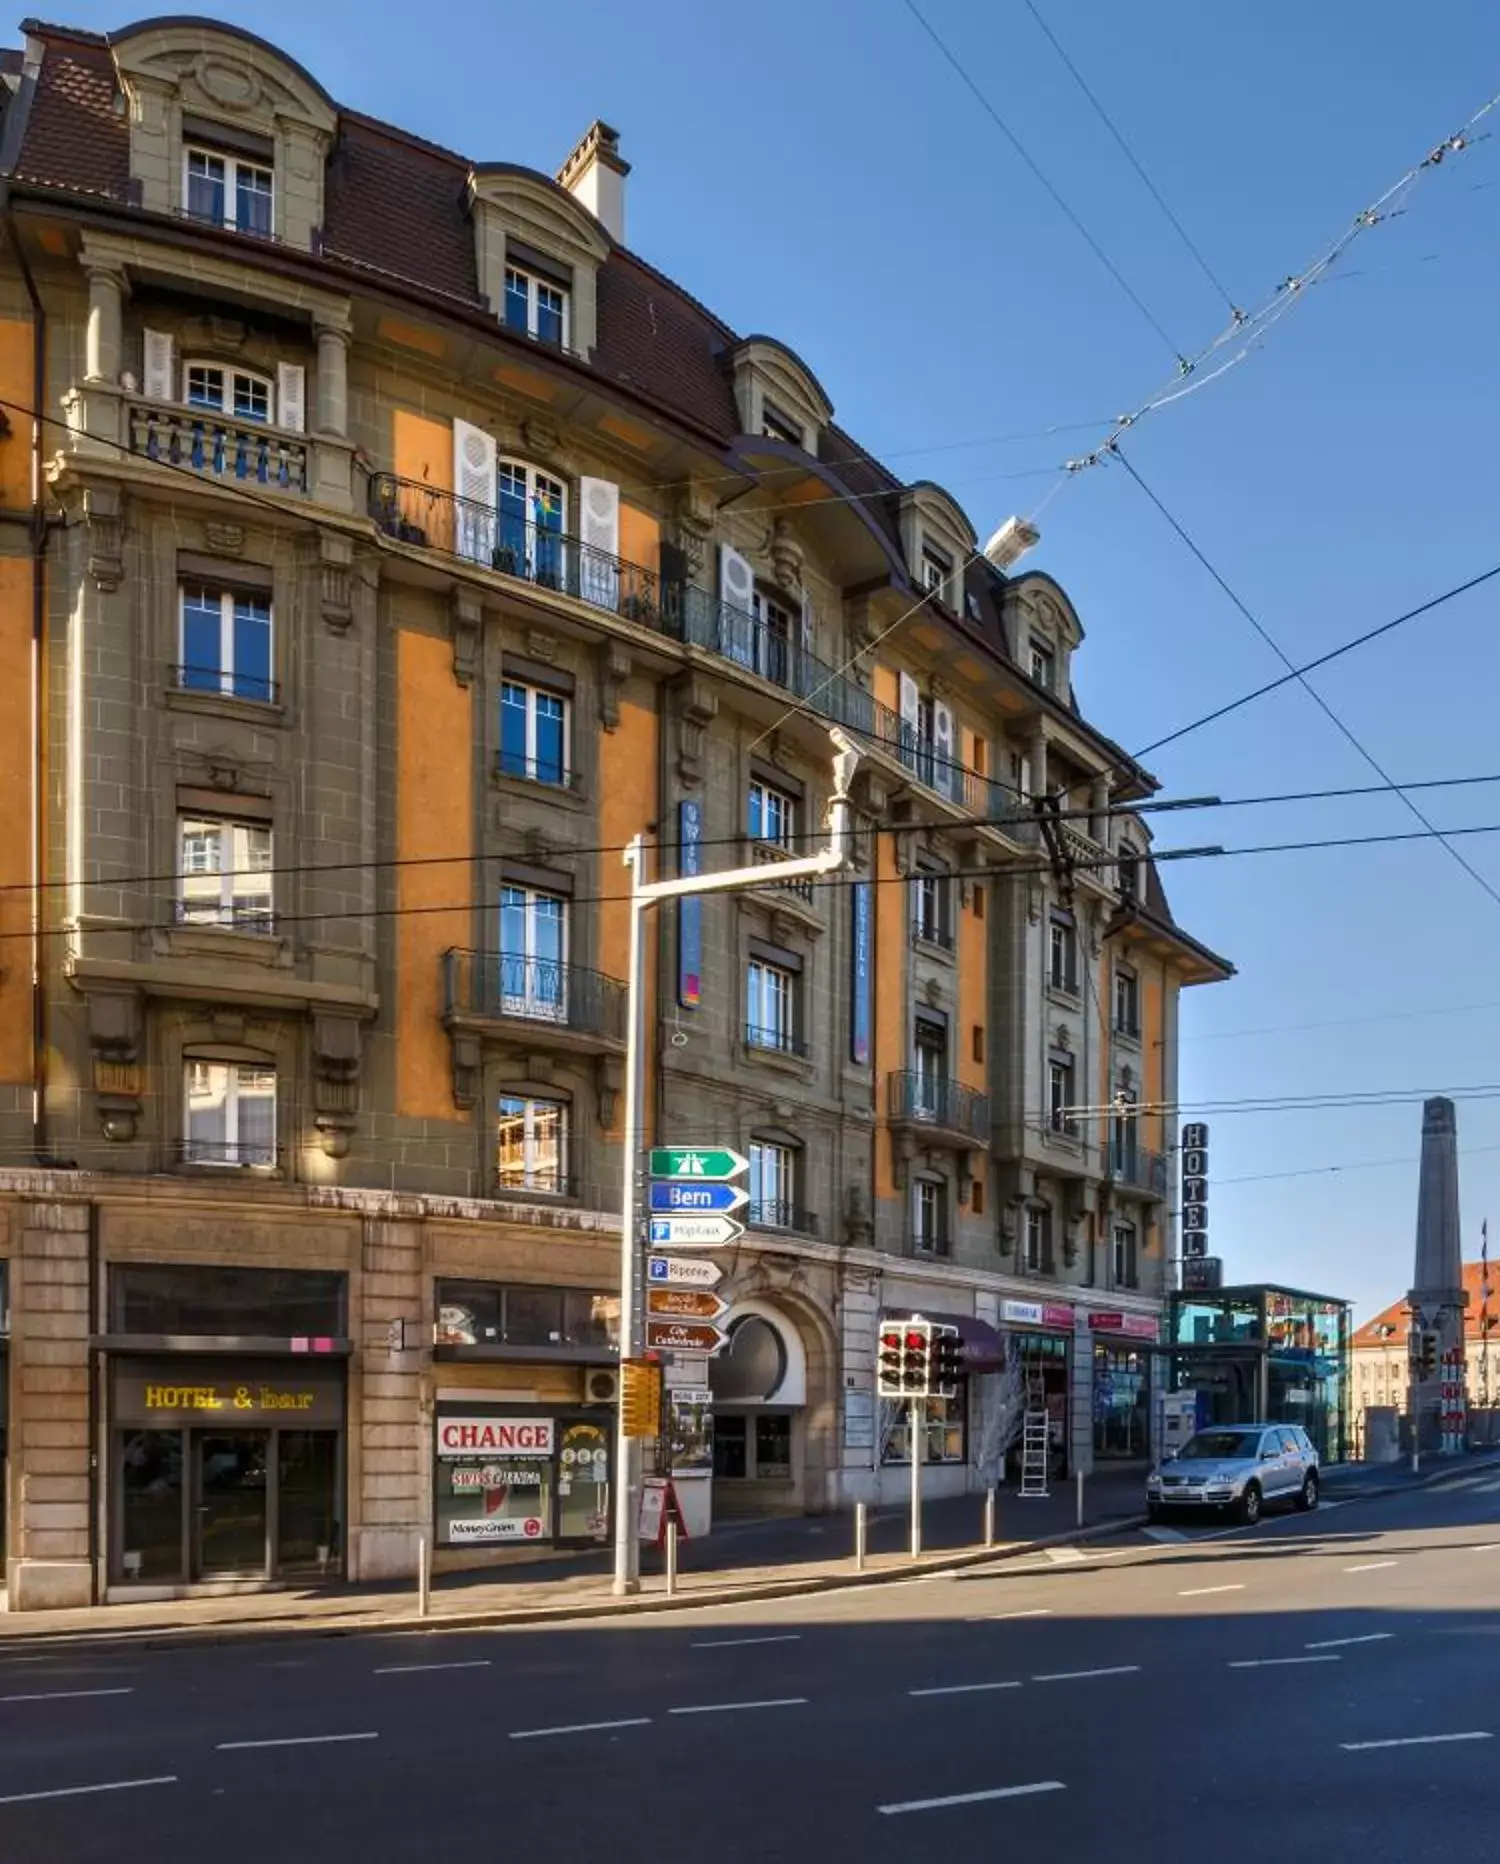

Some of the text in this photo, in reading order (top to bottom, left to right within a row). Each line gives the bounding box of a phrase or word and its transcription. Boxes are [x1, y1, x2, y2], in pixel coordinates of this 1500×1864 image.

[669, 1187, 711, 1207] Bern
[1187, 1125, 1201, 1255] HOTEL
[145, 1386, 222, 1408] HOTEL
[233, 1386, 252, 1409] &
[442, 1425, 549, 1449] CHANGE
